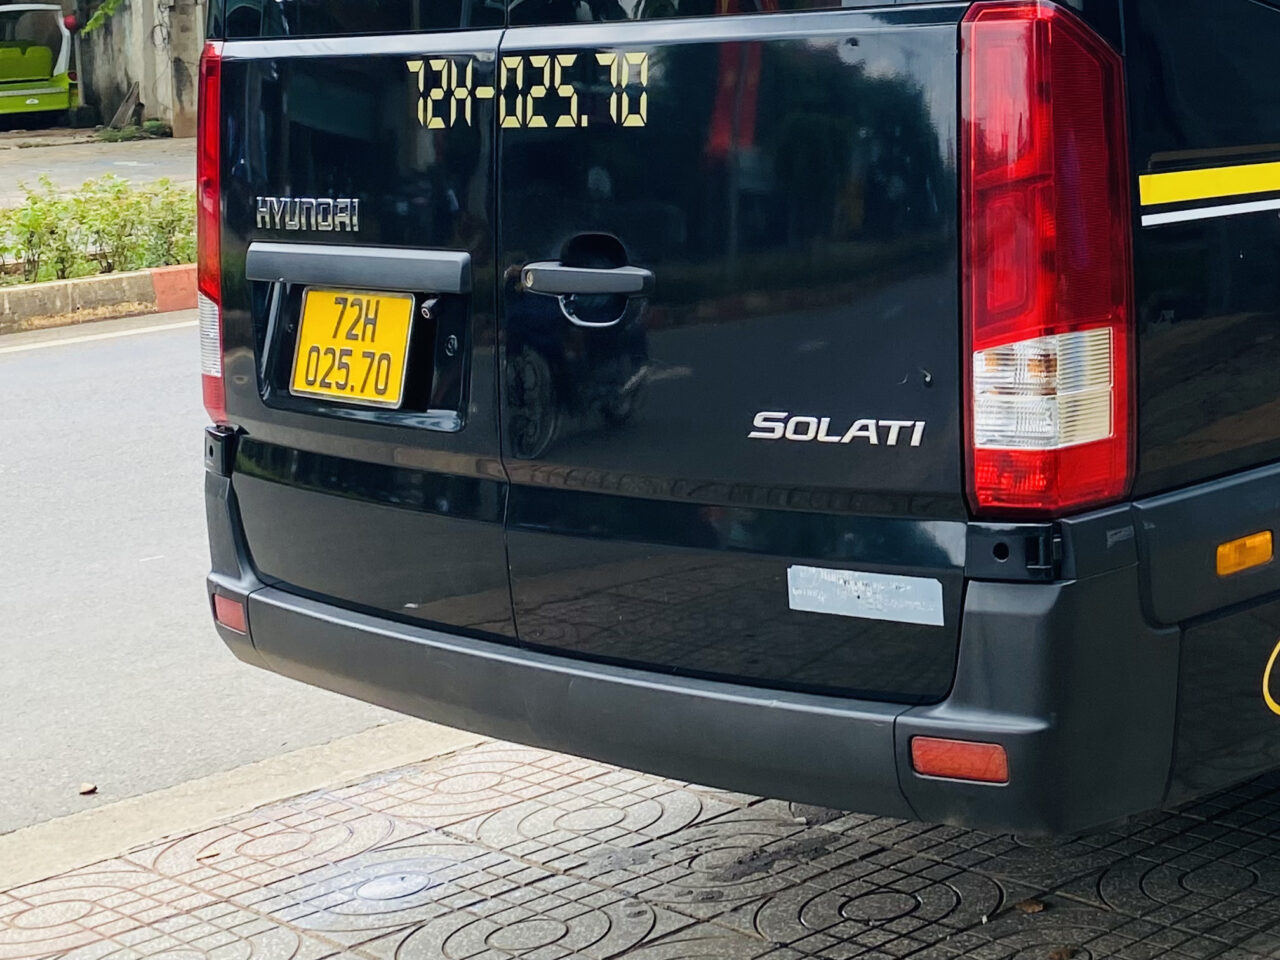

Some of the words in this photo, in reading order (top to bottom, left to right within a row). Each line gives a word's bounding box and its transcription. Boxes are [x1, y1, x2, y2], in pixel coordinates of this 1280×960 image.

[255, 196, 360, 232] HYUNDAI
[332, 296, 378, 342] 72H
[304, 349, 392, 396] 025.70
[747, 411, 926, 447] SOLATI
